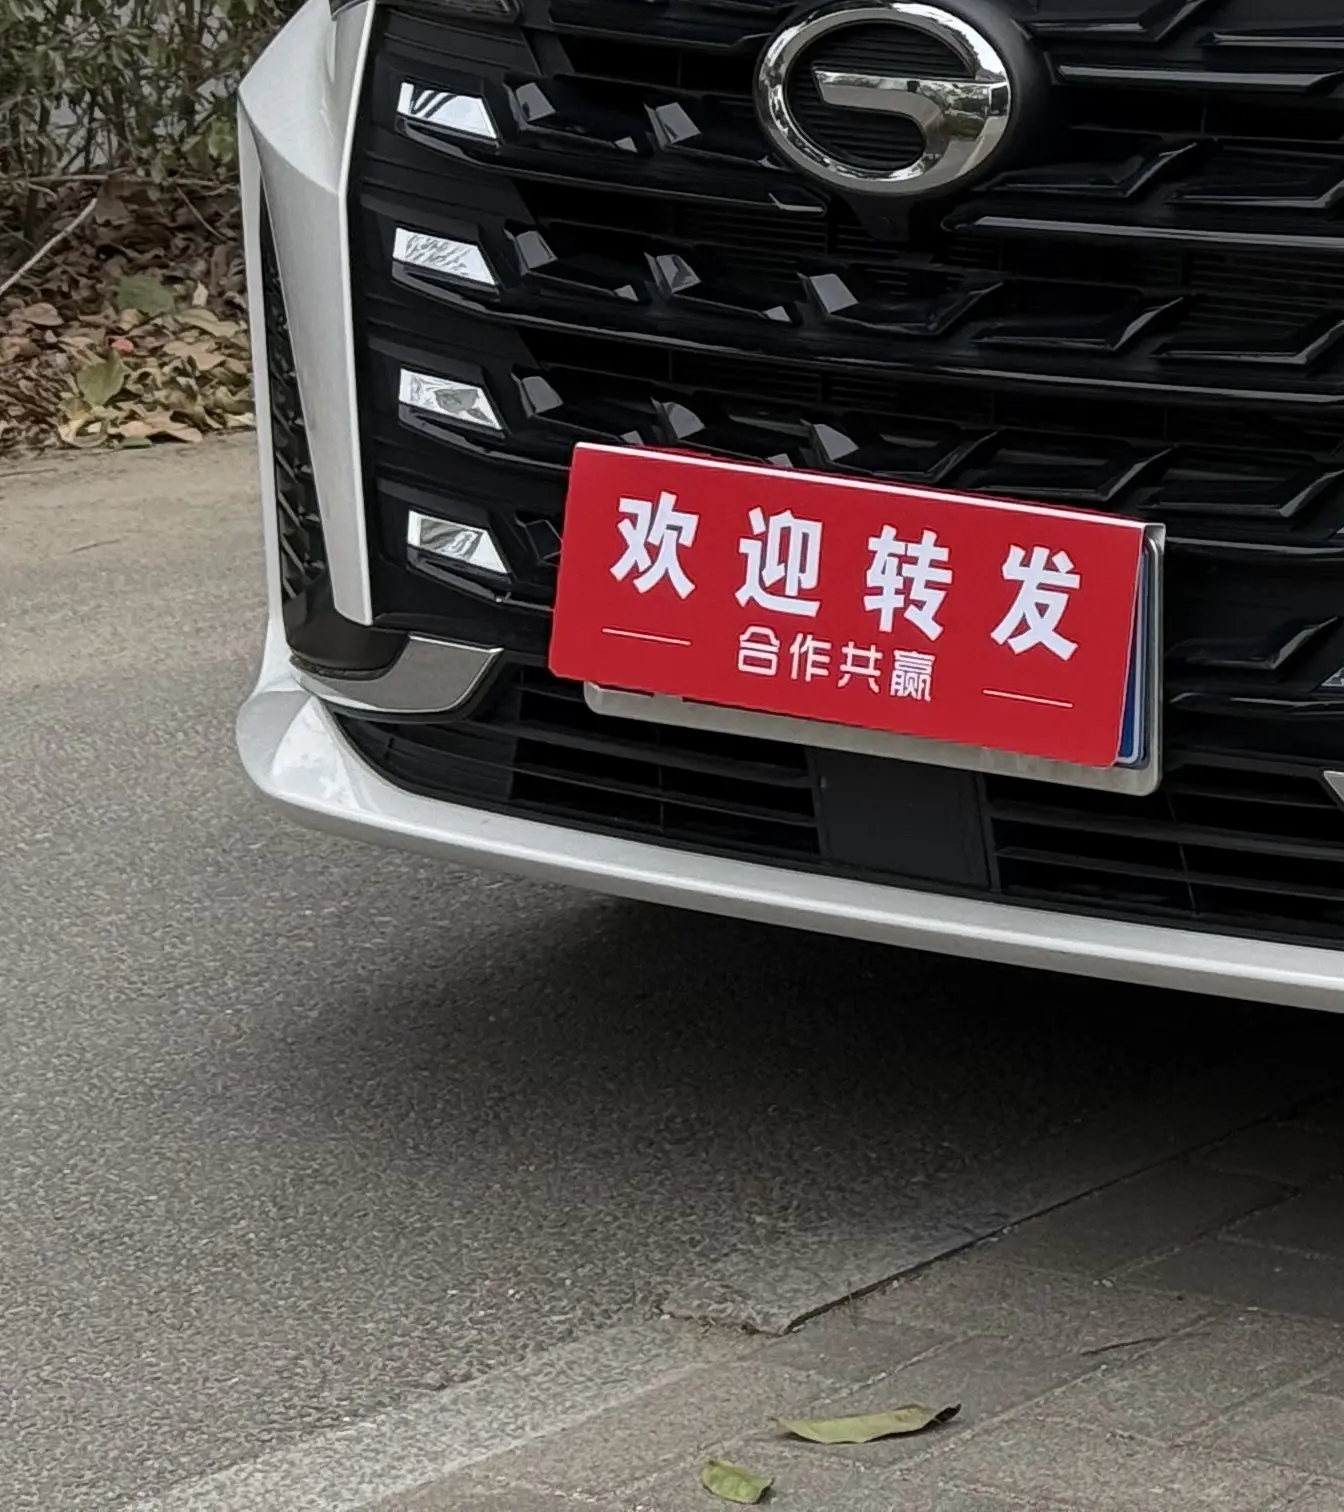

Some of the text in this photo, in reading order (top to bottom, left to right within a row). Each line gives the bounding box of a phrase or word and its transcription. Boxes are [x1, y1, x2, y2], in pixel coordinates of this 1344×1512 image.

[610, 491, 1081, 661] 欢迎转发
[737, 626, 935, 702] 合作共赢
